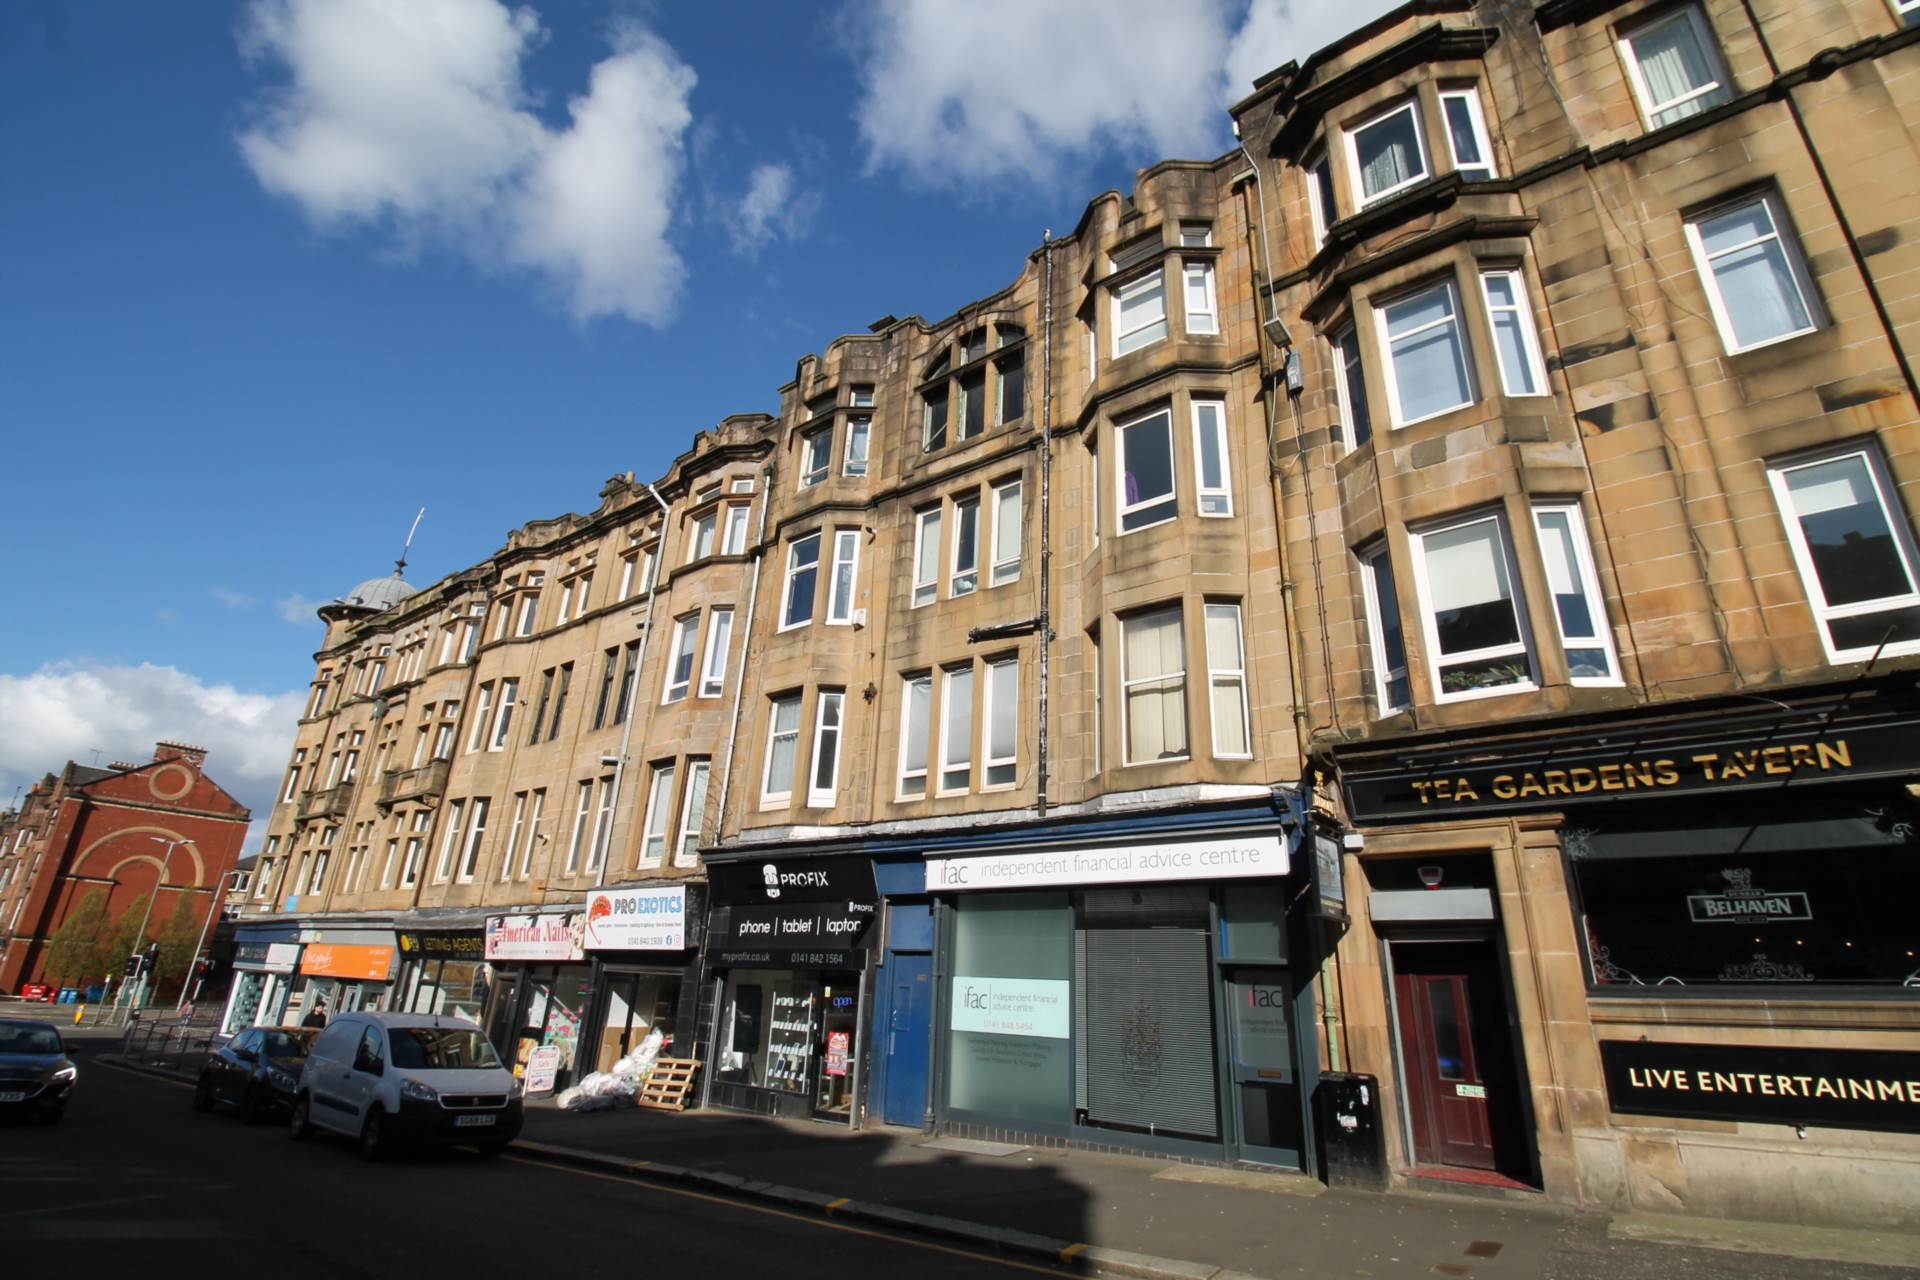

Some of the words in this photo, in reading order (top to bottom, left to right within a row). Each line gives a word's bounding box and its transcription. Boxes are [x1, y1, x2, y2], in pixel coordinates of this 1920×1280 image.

[1412, 777, 1478, 804] TEA
[1492, 759, 1681, 799] GARDENS
[1692, 740, 1852, 780] TAVERN
[981, 856, 1068, 880] independent
[1074, 853, 1132, 873] financial
[1139, 849, 1191, 868] advice
[1200, 848, 1261, 866] centre
[780, 871, 829, 887] PROFIX
[854, 903, 873, 912] PROFIX
[1704, 898, 1792, 917] BELHAVEN
[503, 922, 541, 943] American
[543, 920, 570, 943] Nails
[739, 919, 771, 936] phone
[782, 918, 813, 933] tablet
[452, 937, 484, 952] AGENTS
[721, 952, 771, 963] myprofix.co.uk
[791, 953, 807, 963] 0141
[810, 953, 824, 963] 842
[826, 954, 843, 964] 1564
[832, 996, 853, 1008] open
[964, 986, 988, 1009] ifac
[1629, 1067, 1690, 1090] LIVE
[1697, 1071, 1920, 1102] ENTERTAINME
